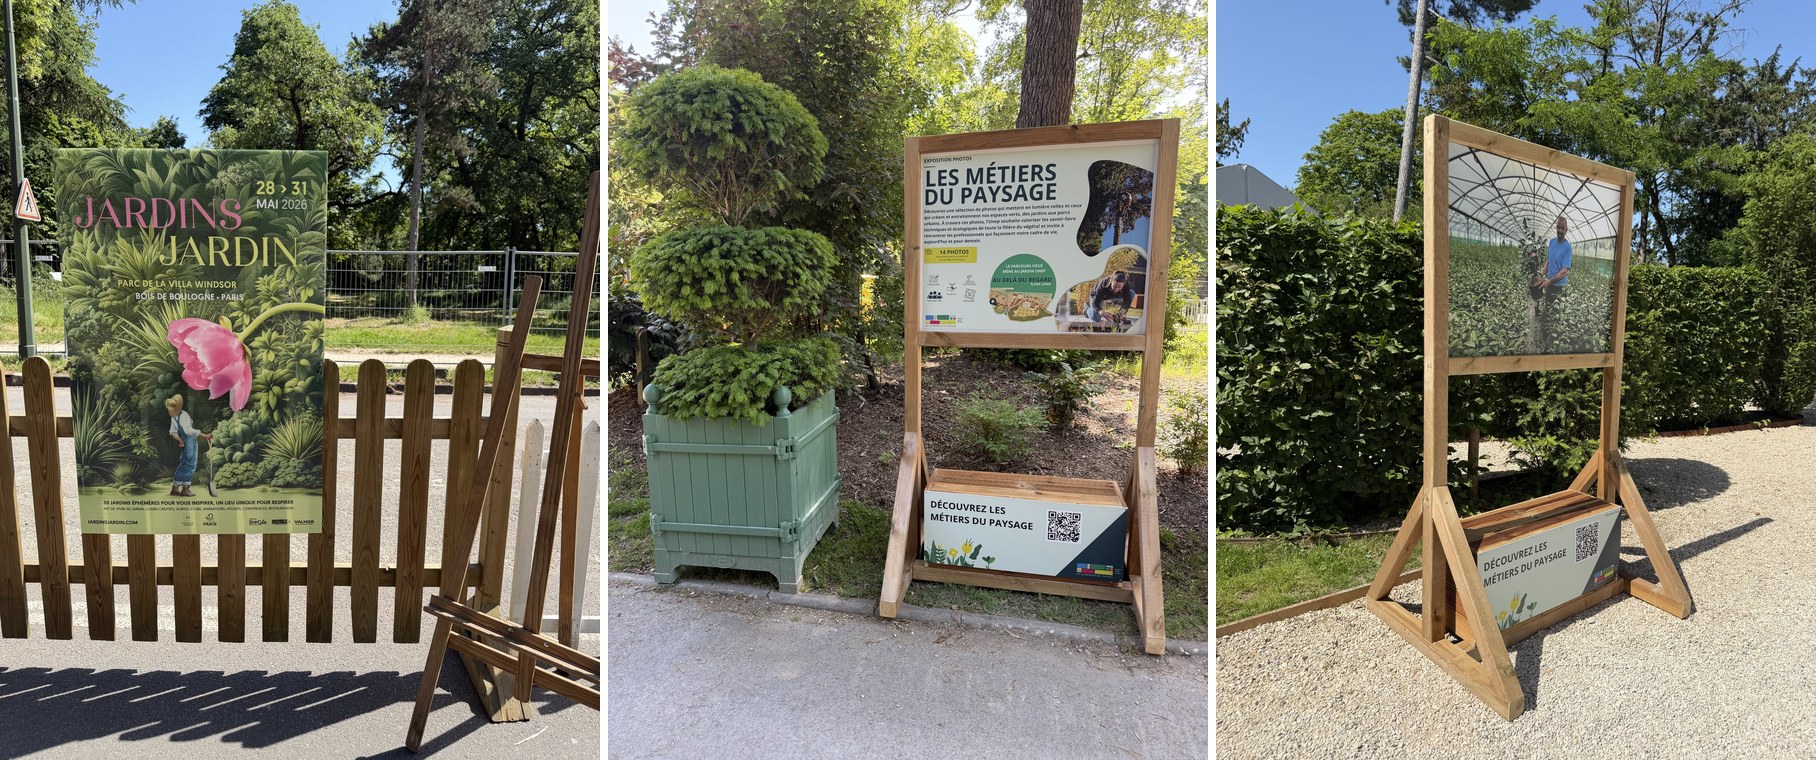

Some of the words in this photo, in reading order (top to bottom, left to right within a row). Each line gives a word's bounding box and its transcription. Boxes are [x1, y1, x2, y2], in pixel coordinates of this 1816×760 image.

[926, 169, 959, 187] LES
[966, 162, 1056, 185] MÉTIERS
[256, 181, 275, 195] 28
[292, 181, 307, 195] 31
[925, 188, 953, 205] DU
[961, 183, 1057, 204] PAYSAGE
[76, 197, 242, 230] JARDINS
[256, 199, 278, 210] MAI
[281, 199, 308, 210] 2026
[159, 236, 298, 267] JARDIN
[169, 280, 192, 288] VILLA
[195, 281, 237, 289] WINDSOR
[930, 500, 987, 513] DÉCOUVREZ
[989, 506, 1006, 515] LES
[930, 512, 970, 524] MÉTIERS
[972, 517, 987, 526] DU
[989, 519, 1034, 530] PAYSAGE
[1483, 566, 1519, 588] MÉTIERS
[1521, 561, 1532, 573] DU
[1534, 548, 1567, 567] PAYSAGE
[1484, 546, 1533, 572] DÉCOUVREZ
[1534, 542, 1547, 553] LES
